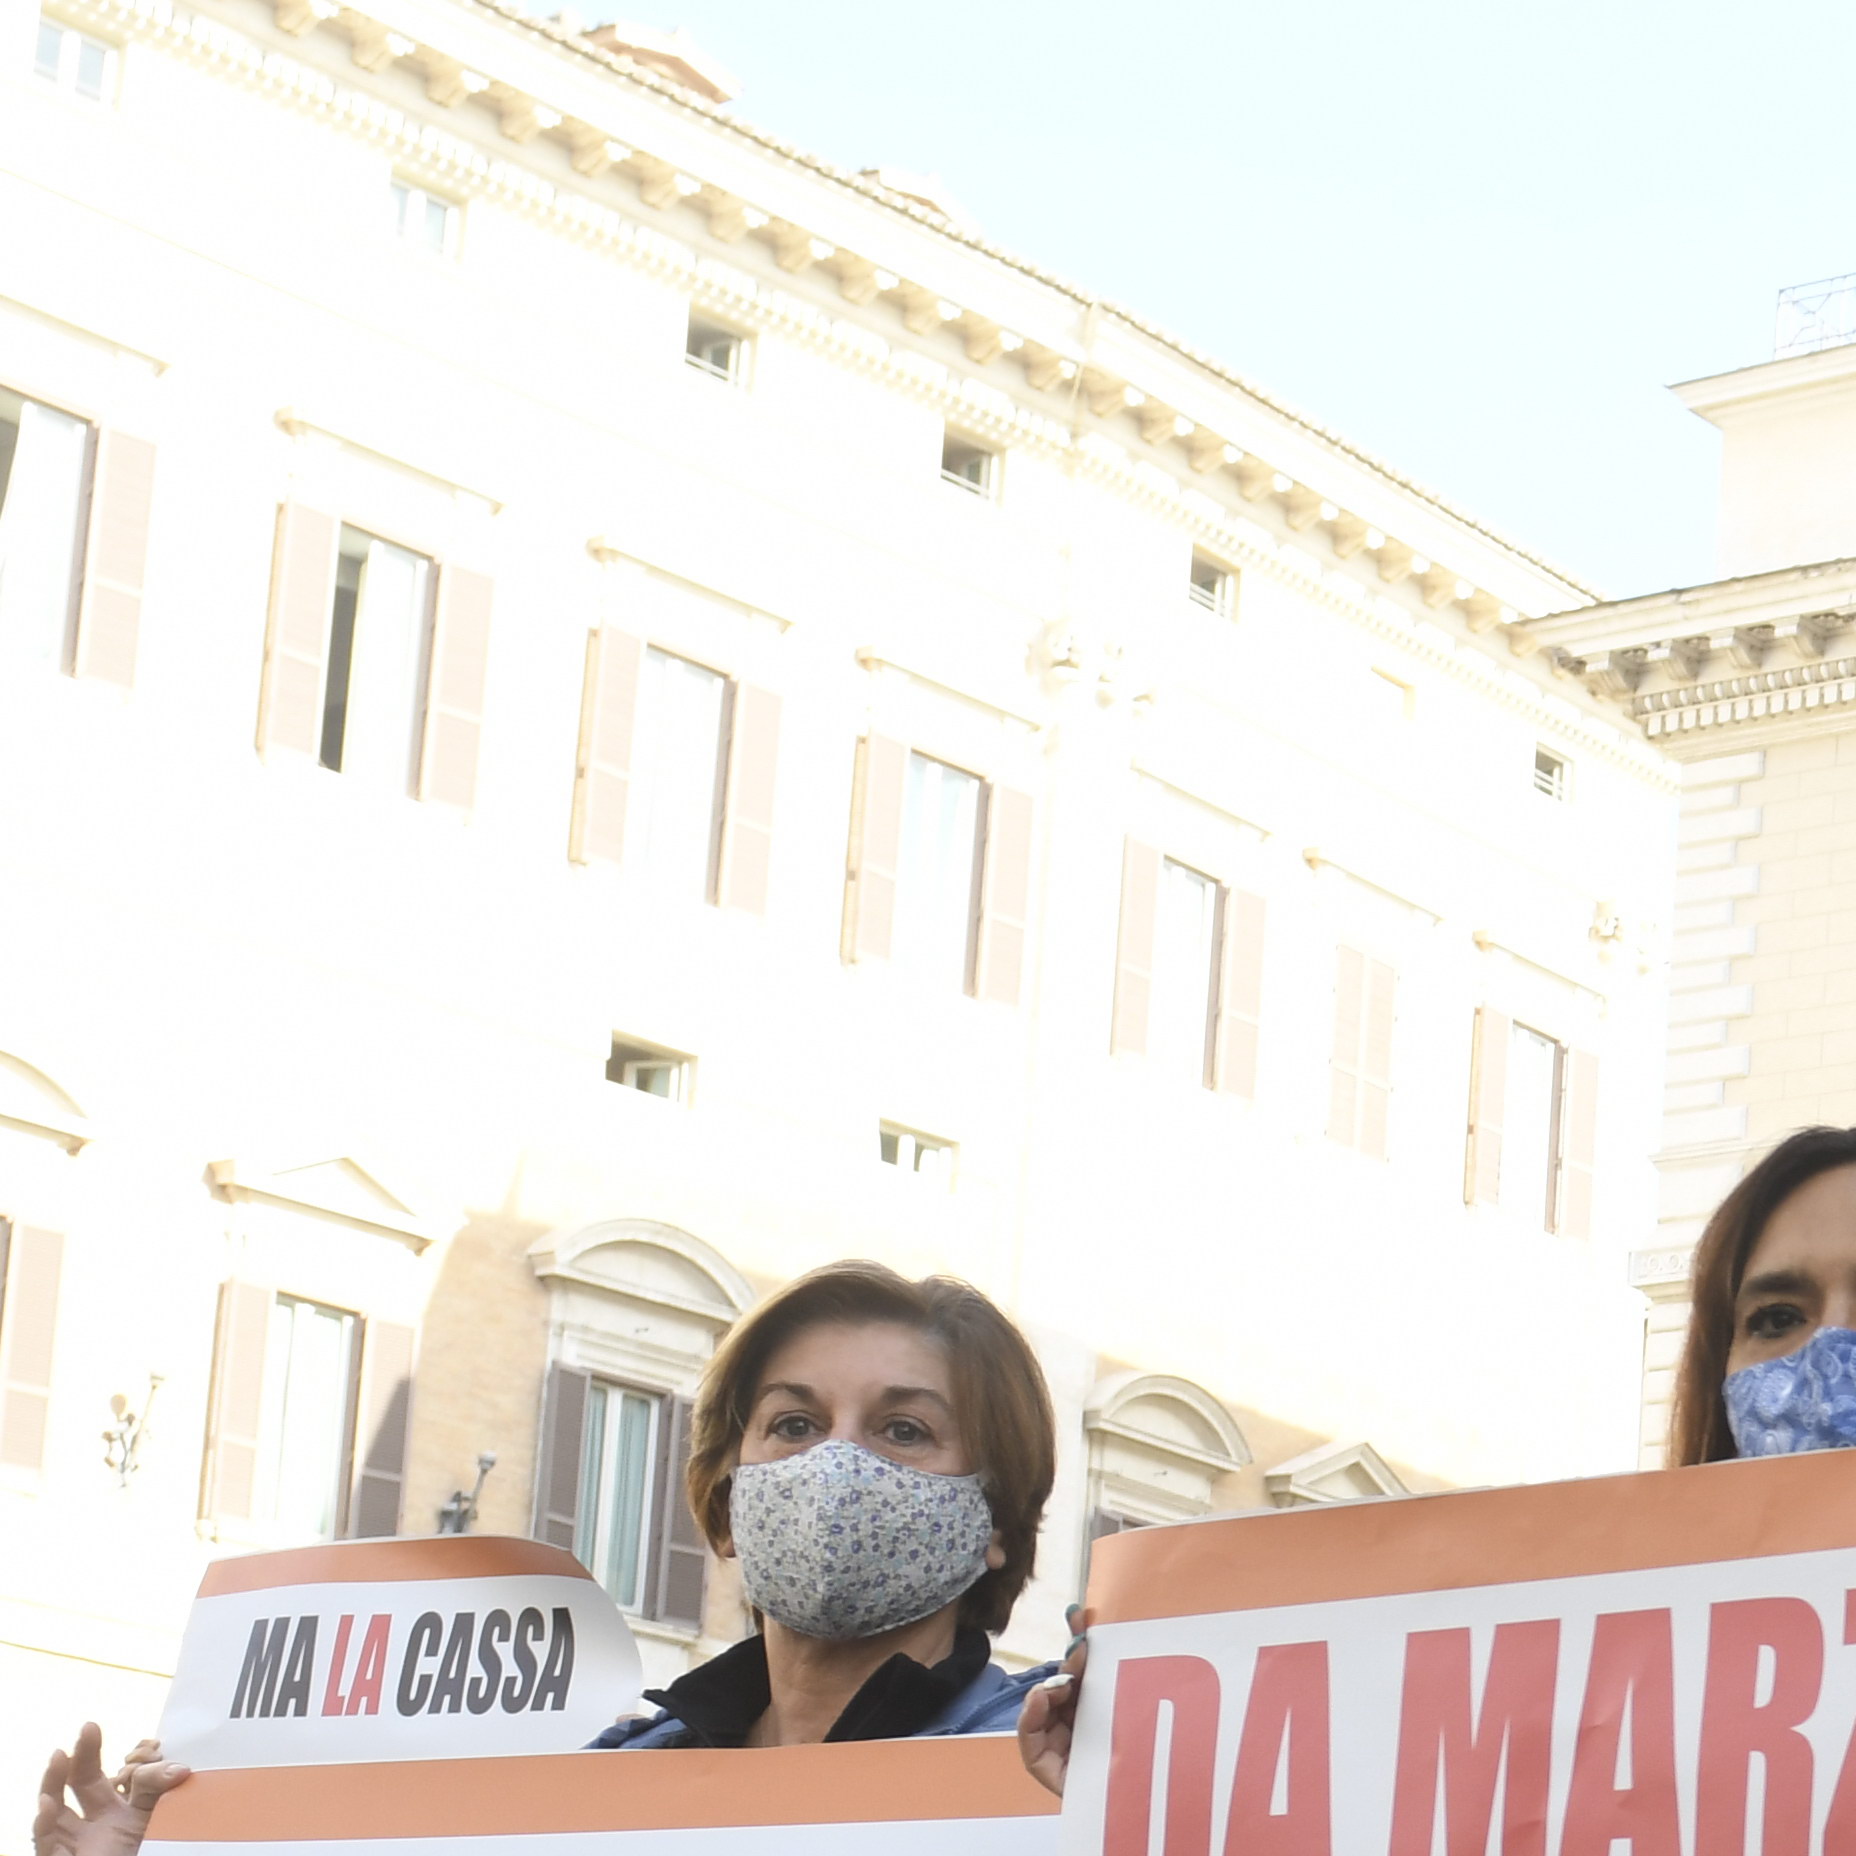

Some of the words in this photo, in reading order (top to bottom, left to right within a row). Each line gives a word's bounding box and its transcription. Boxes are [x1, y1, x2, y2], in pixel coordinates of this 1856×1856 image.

[231, 1614, 319, 1719] MA
[321, 1613, 389, 1717] LA
[396, 1606, 575, 1718] CASSA
